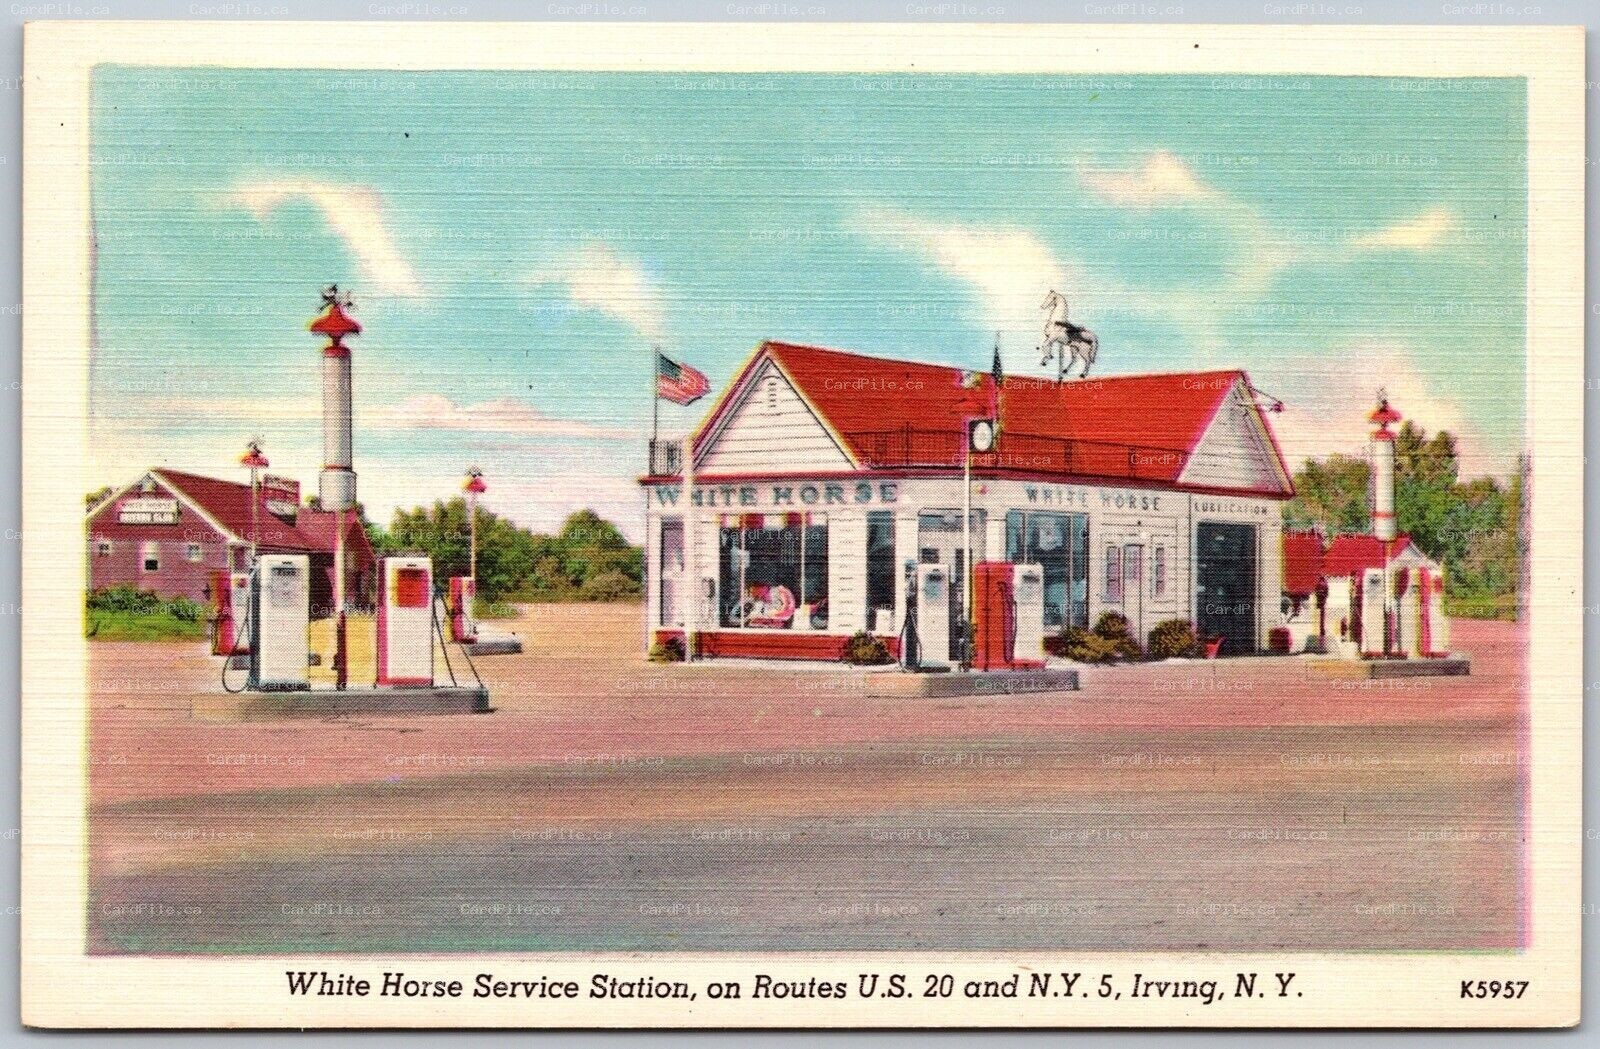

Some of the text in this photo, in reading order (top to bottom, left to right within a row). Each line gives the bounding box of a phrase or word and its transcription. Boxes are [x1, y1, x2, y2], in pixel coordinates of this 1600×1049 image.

[772, 481, 898, 506] HORSE
[1024, 484, 1161, 511] WHITE HORSE
